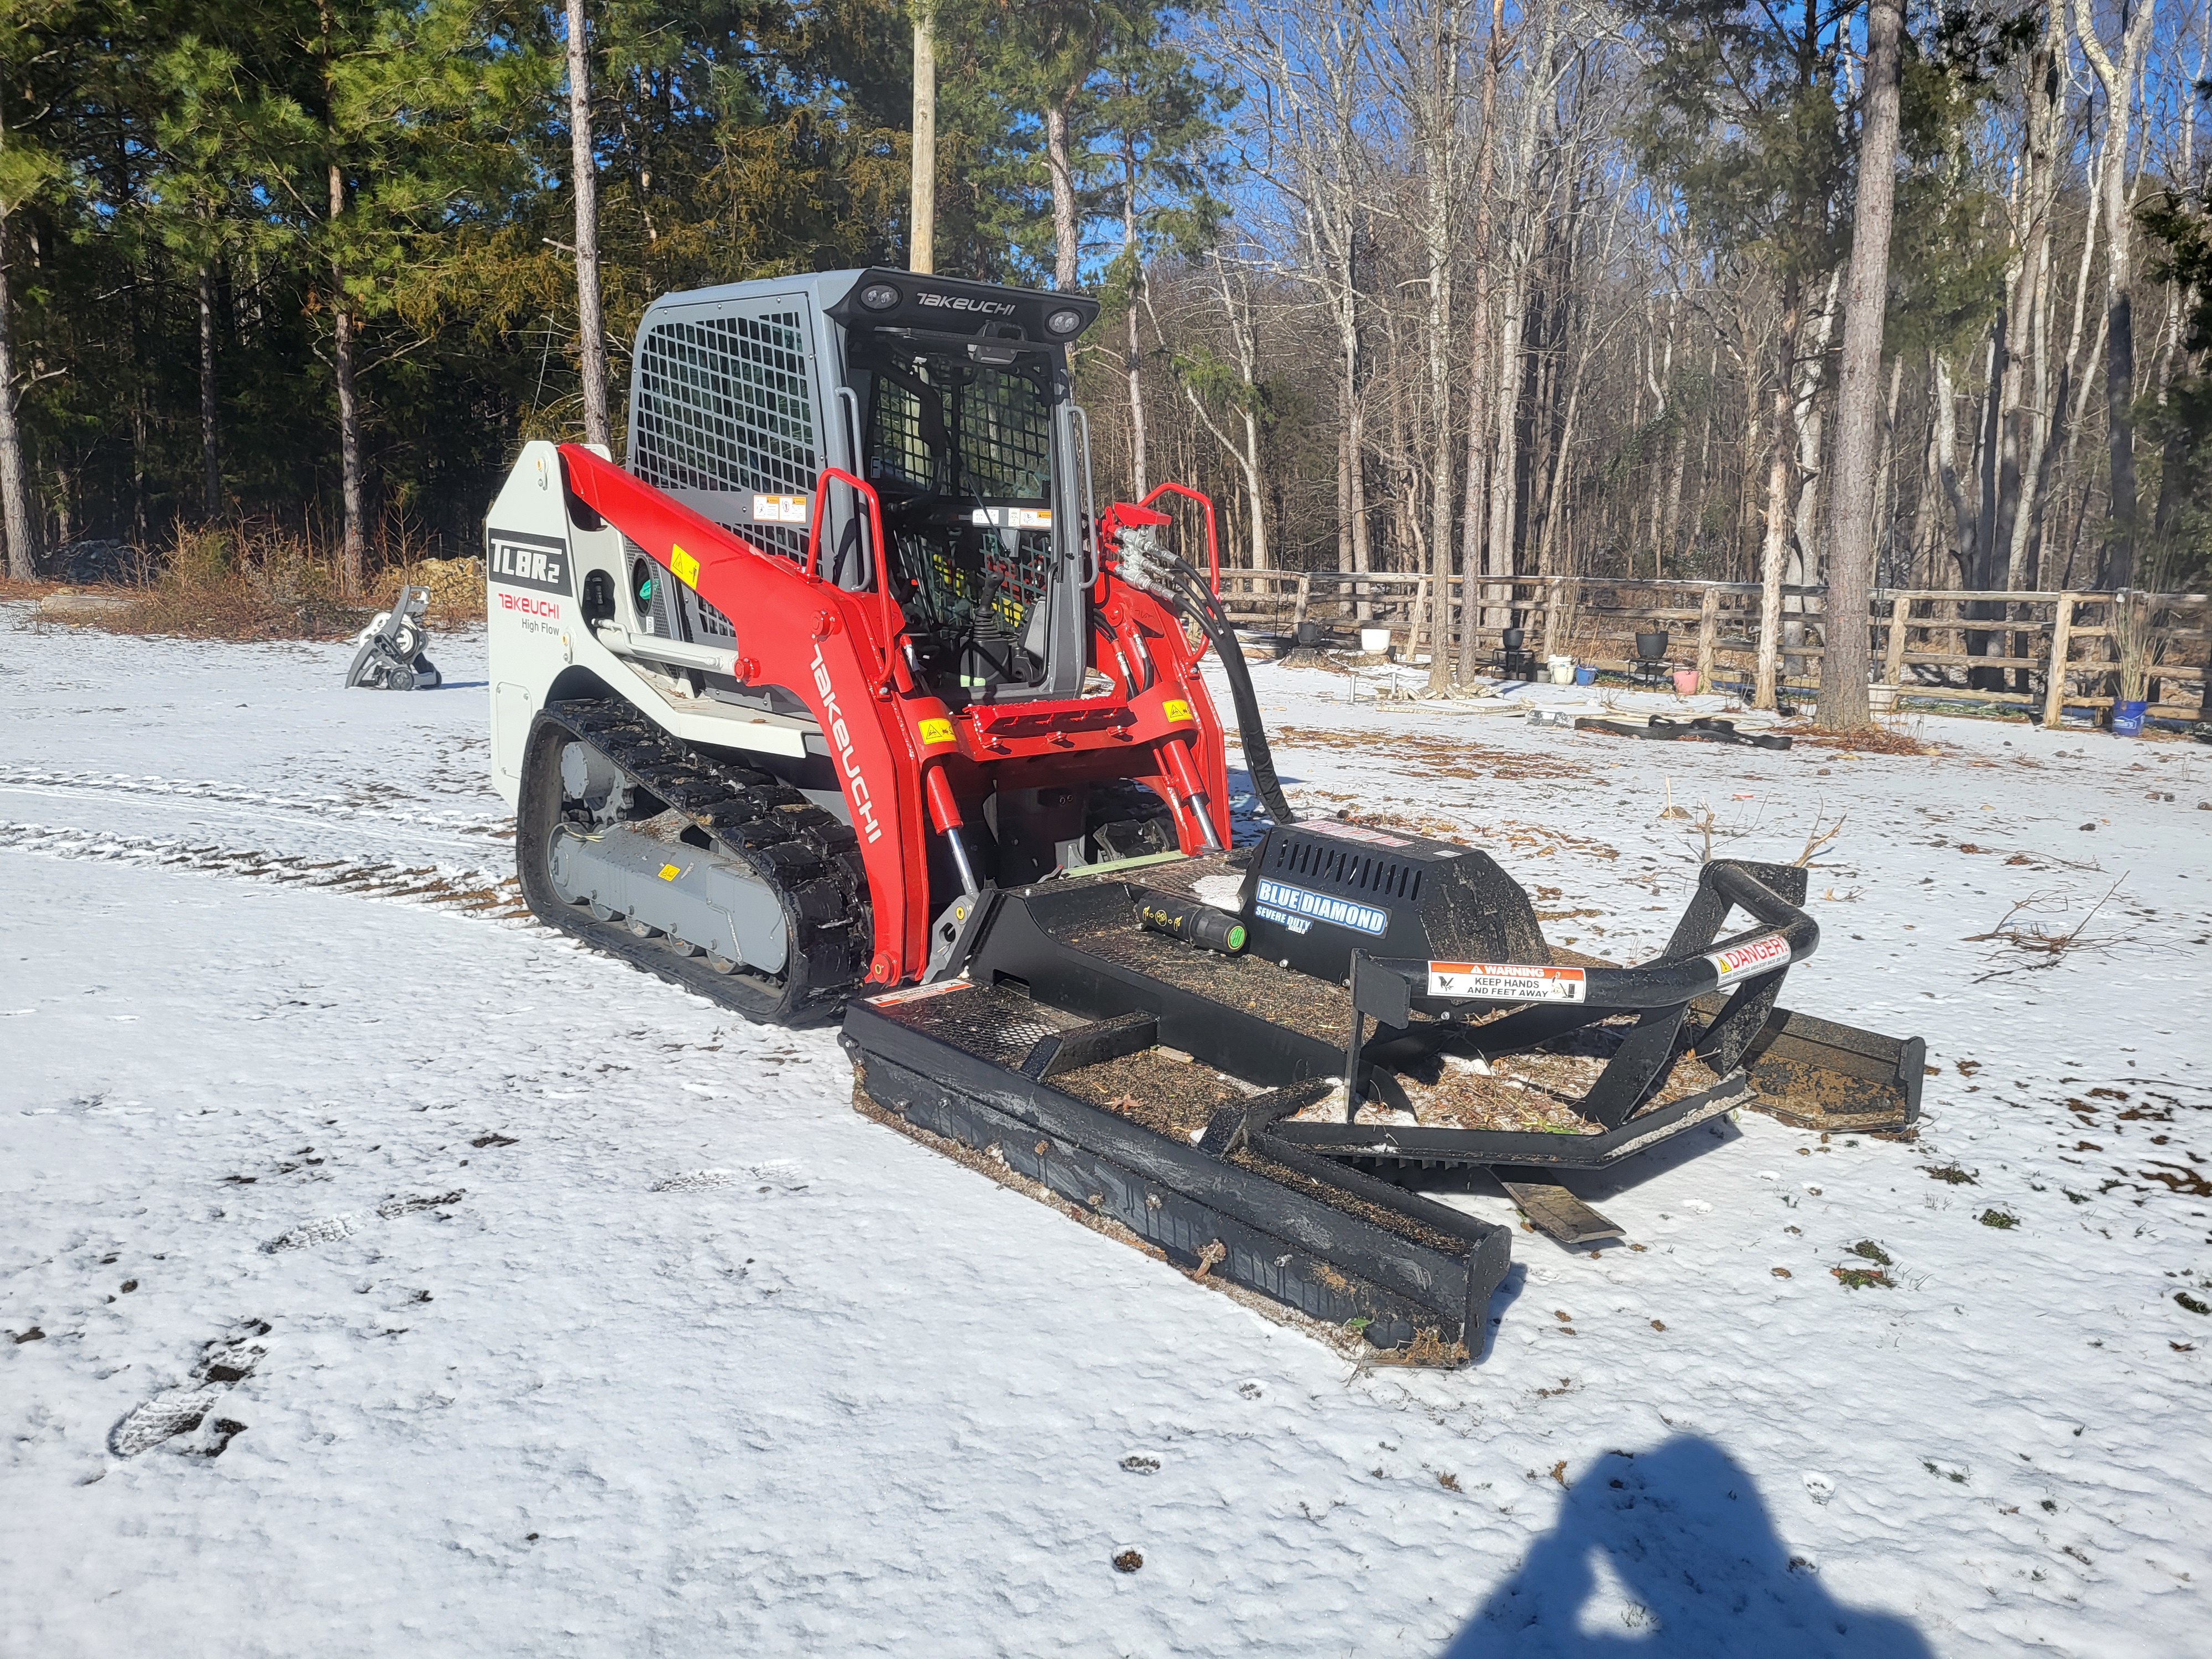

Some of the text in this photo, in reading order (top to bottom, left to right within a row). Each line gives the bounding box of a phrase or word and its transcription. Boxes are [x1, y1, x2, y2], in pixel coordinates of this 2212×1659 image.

[491, 538, 562, 584] TL8R2
[521, 618, 560, 636] High Flow
[1258, 881, 1385, 932] BLUE DIAMOND
[1255, 905, 1312, 931] SEVERE DUTY
[1288, 924, 1302, 933] SERIES
[1724, 937, 1789, 969] DANGER!
[1484, 966, 1545, 978] WARNING
[1475, 977, 1540, 989] KEEP HANDS
[1467, 987, 1549, 998] AND FEET AWAY
